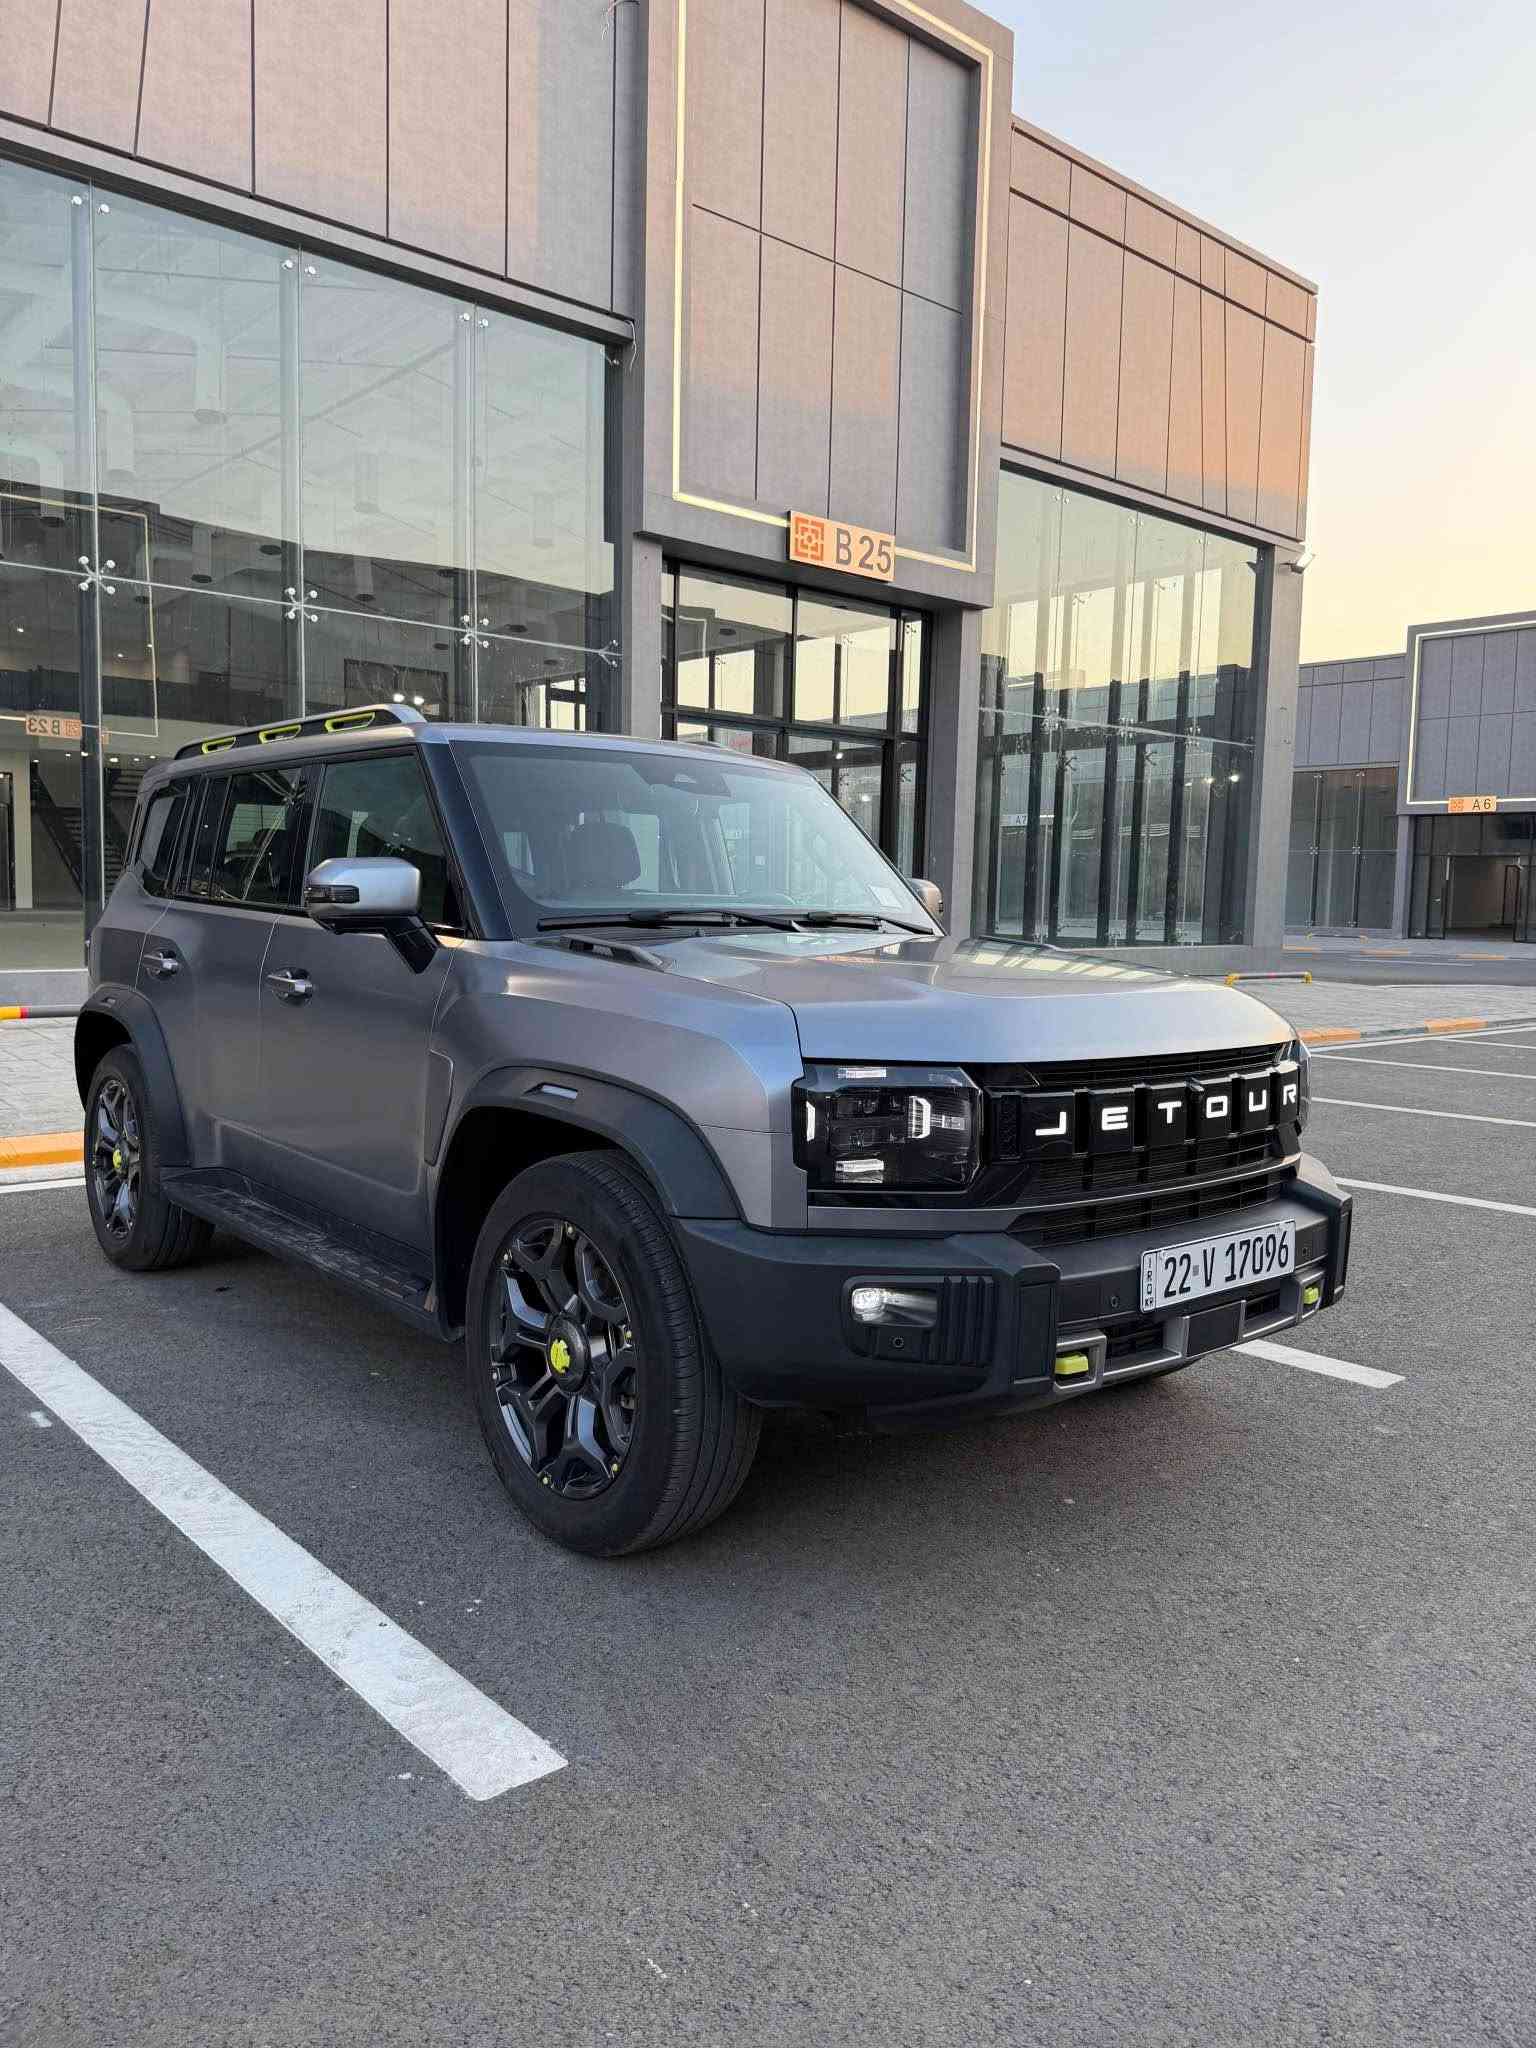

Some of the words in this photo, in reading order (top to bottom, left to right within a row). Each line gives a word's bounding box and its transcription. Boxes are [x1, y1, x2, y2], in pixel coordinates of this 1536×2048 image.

[1035, 1083, 1297, 1136] JETOUR
[1163, 1253, 1192, 1298] 22
[1202, 1247, 1216, 1288] V
[1224, 1230, 1289, 1283] 17096
